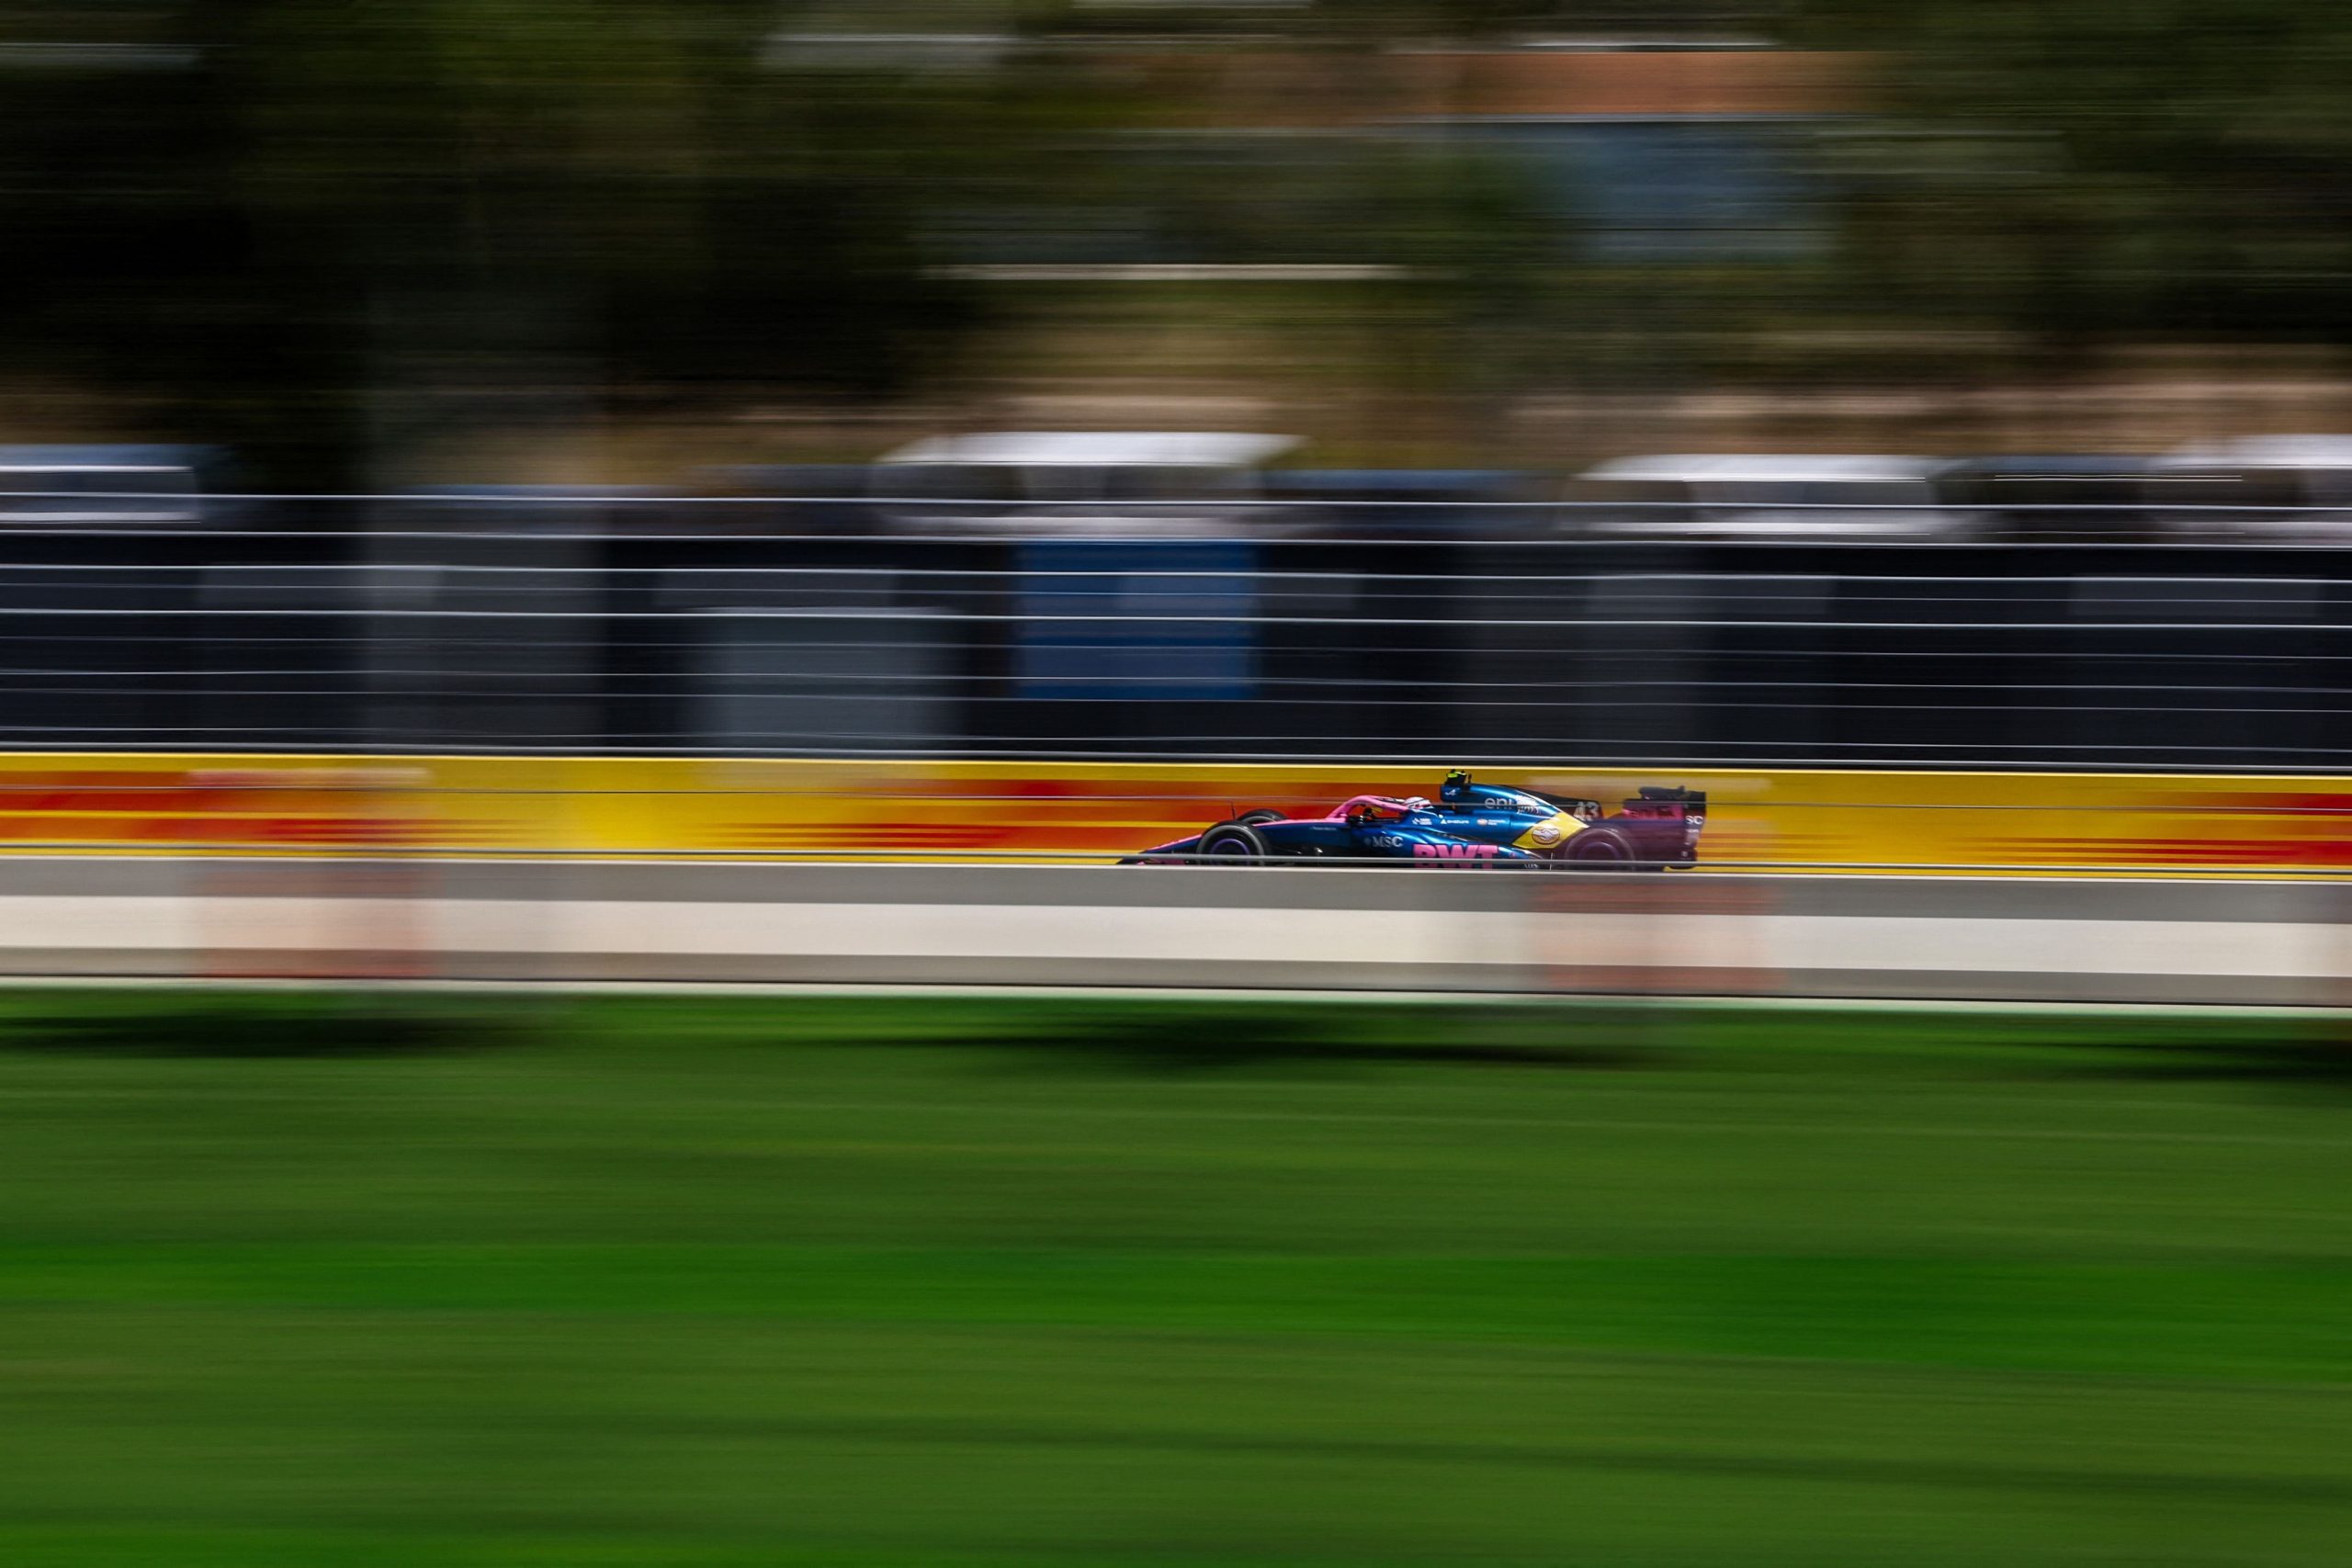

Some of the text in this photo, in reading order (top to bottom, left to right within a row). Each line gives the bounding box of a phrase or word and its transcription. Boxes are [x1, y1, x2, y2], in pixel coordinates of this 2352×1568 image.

[1484, 797, 1512, 809] eni
[1573, 801, 1599, 821] 43
[1372, 836, 1403, 847] MSC
[1413, 843, 1498, 869] BWT
